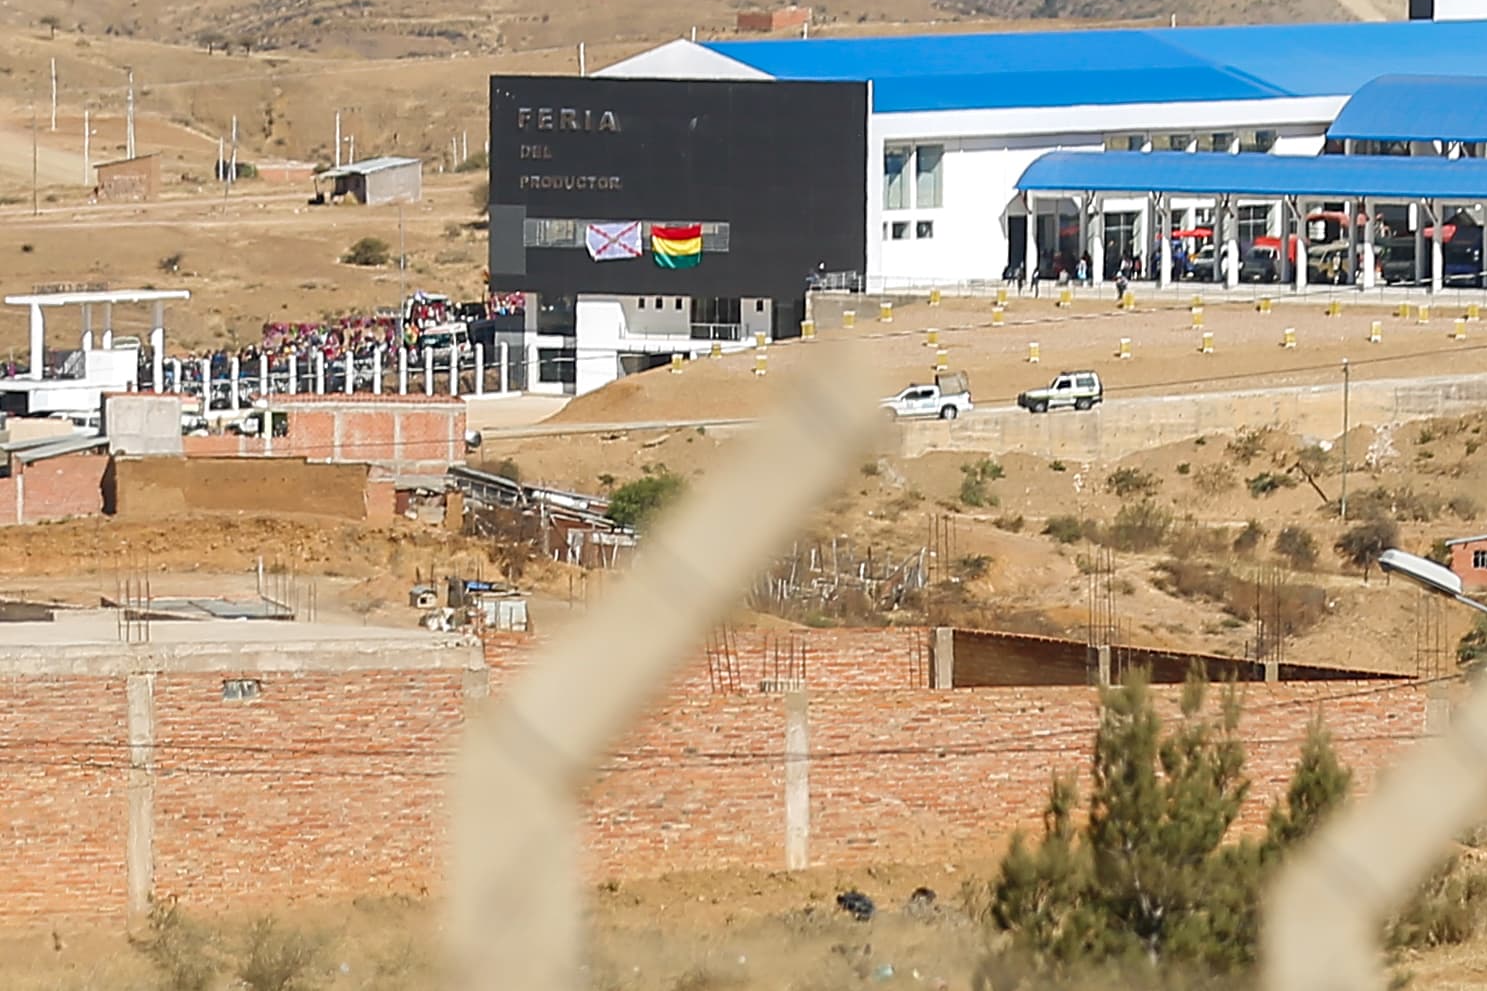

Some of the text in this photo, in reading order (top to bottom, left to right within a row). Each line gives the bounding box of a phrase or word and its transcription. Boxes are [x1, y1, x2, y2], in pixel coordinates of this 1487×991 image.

[518, 108, 622, 131] FERIA
[520, 144, 552, 159] DEL
[520, 176, 622, 189] PRODUCTOR
